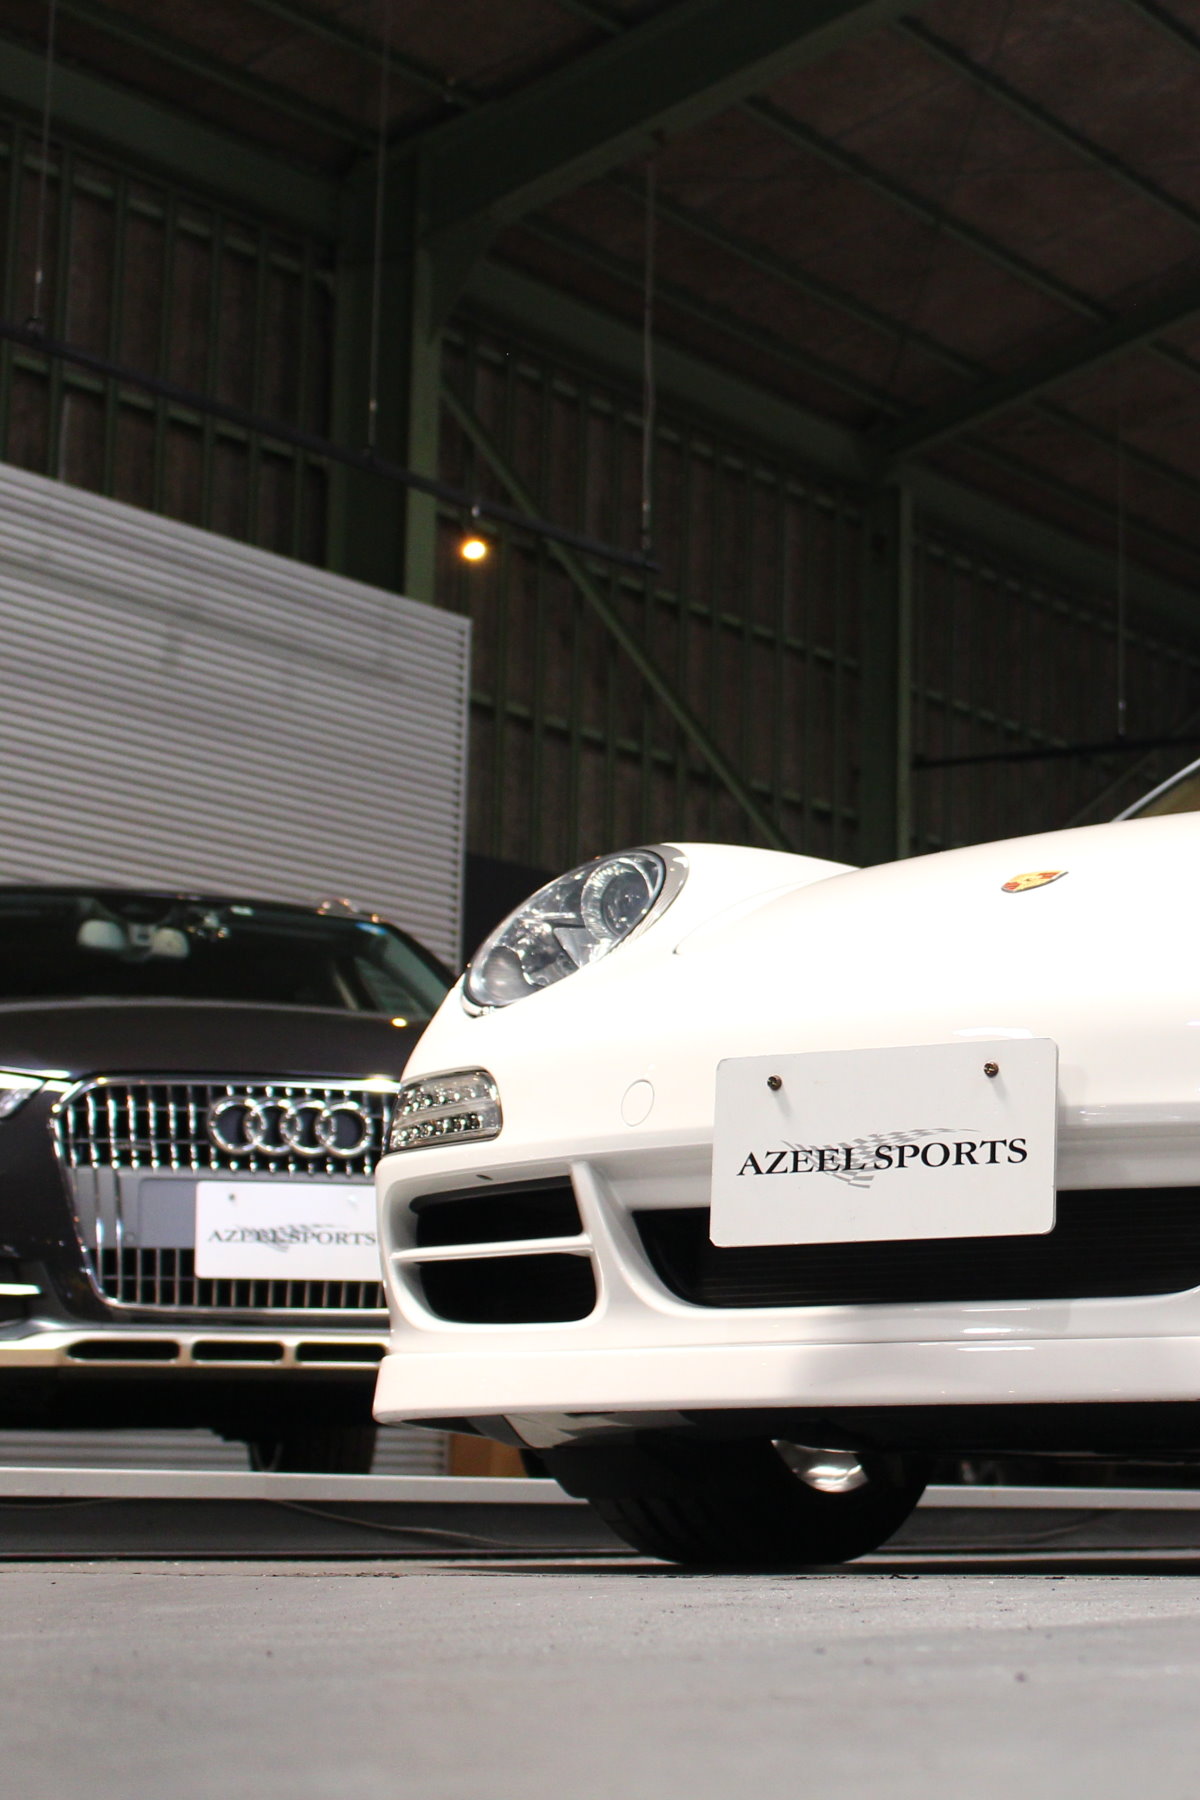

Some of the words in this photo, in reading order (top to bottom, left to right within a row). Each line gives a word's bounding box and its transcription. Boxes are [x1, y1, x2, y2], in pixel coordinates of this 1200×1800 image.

[736, 1147, 866, 1176] AZEEL
[874, 1138, 1028, 1170] SPORTS
[288, 1229, 377, 1246] SPORTS
